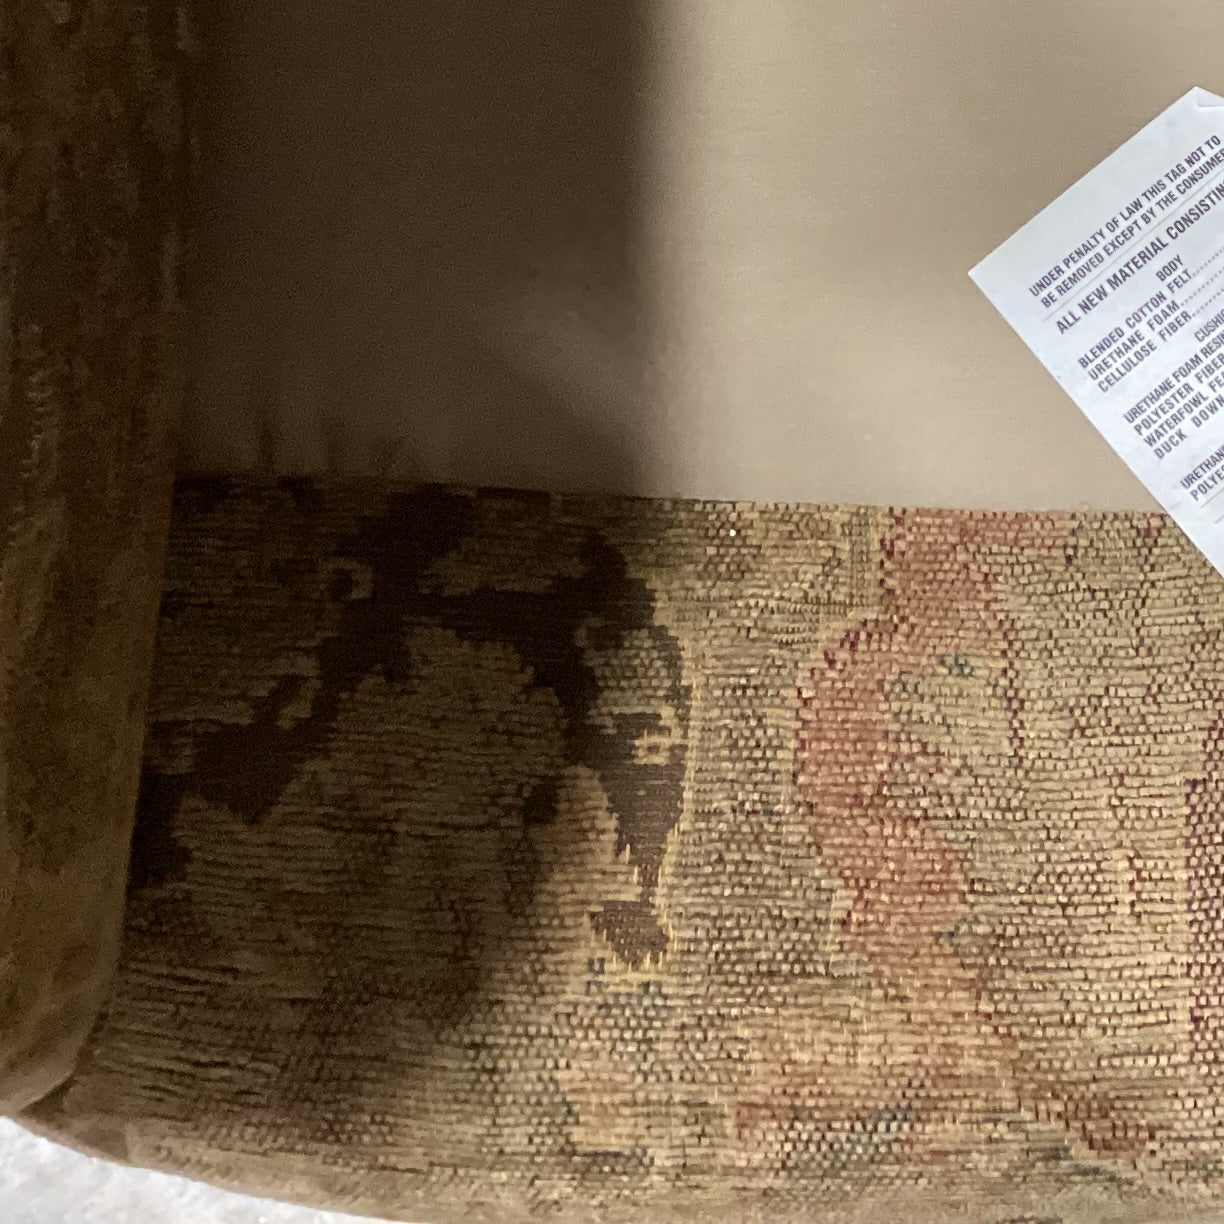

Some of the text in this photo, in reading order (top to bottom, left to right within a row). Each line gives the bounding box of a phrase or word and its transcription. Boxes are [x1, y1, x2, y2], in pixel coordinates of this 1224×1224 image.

[1028, 133, 1222, 297] UNDER PENALTY OF LAW THIS TAG NOT TO
[1040, 291, 1058, 308] BE
[1054, 251, 1105, 296] REMOVED
[1102, 219, 1143, 256] EXCEPT
[1139, 206, 1158, 224] BY
[1155, 190, 1178, 211] THE
[1154, 254, 1185, 282] BODY
[1053, 308, 1081, 334] ALL
[1077, 284, 1110, 314] NEW
[1105, 234, 1169, 290] MATERIAL
[1077, 325, 1126, 368] BLENDED
[1124, 290, 1167, 329] COTTON
[1086, 328, 1146, 380] URETHANE
[1096, 339, 1158, 392] CELLULOSE
[1122, 377, 1176, 424] URETHANE
[1171, 353, 1203, 383] FOAM
[1132, 381, 1195, 436] POLYESTER
[1142, 389, 1210, 448] WATERFOWL
[1153, 428, 1188, 459] DUCK
